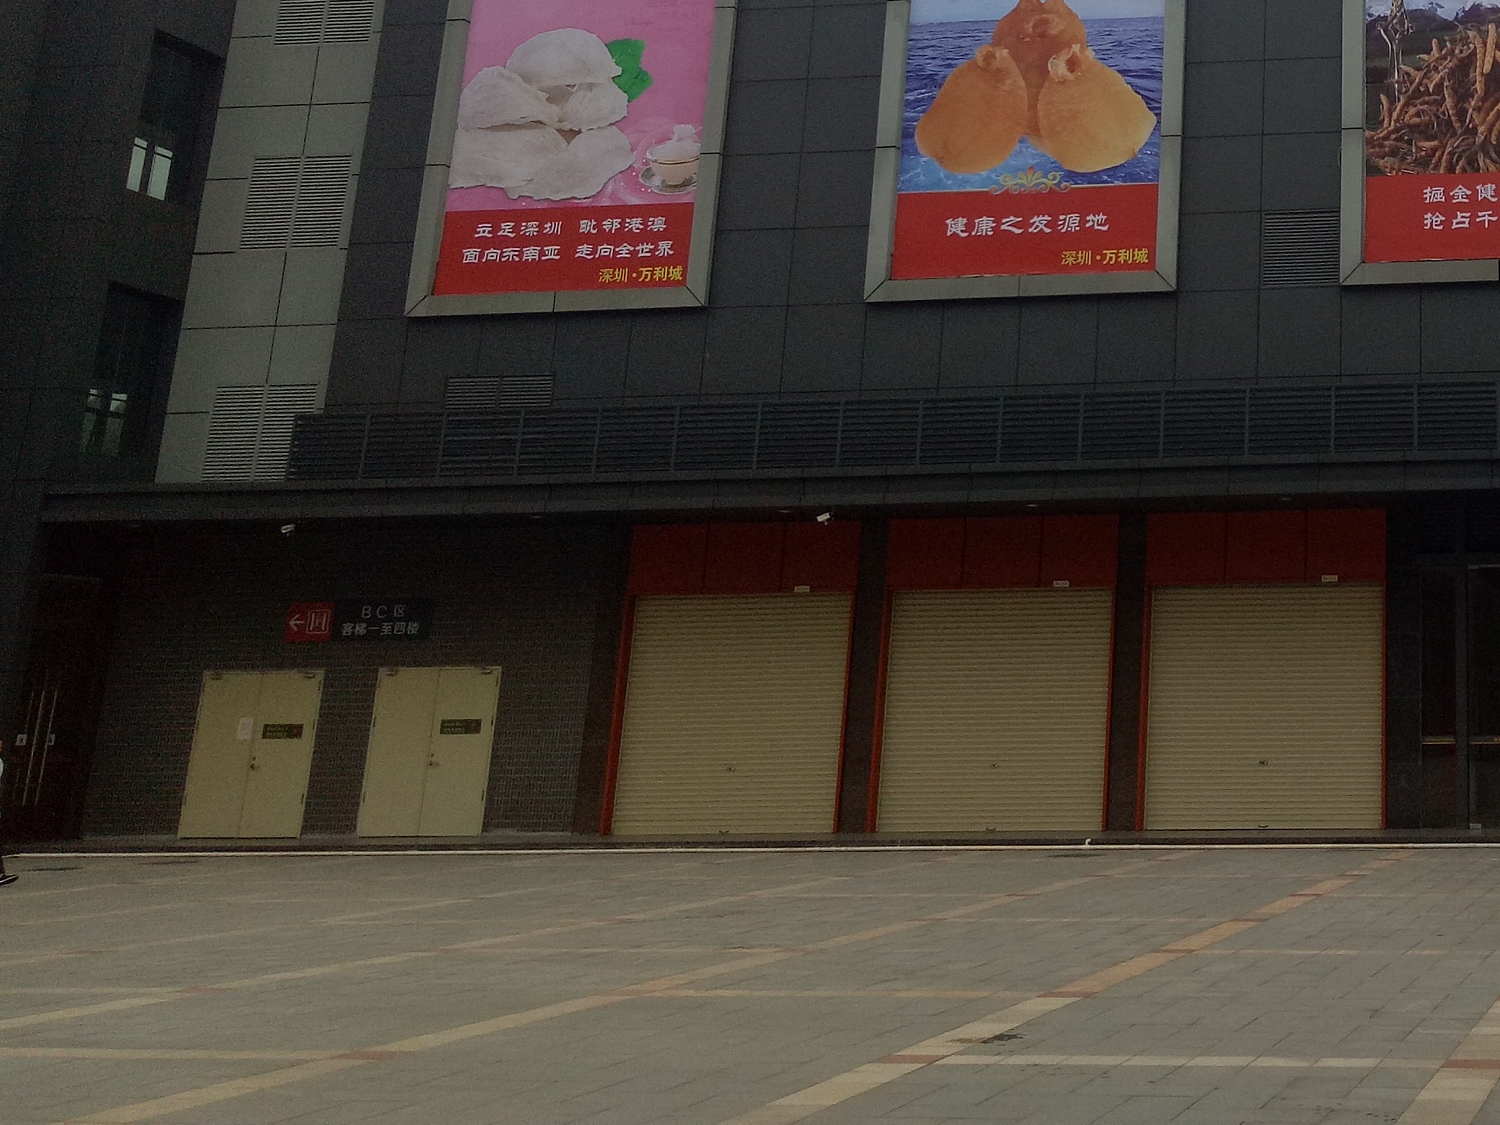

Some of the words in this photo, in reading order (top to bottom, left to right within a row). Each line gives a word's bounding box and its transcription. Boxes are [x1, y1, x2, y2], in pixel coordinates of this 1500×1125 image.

[474, 221, 562, 238] 立足深圳
[579, 217, 667, 234] 毗邻港澳
[945, 212, 1110, 238] 健康之发源地
[462, 245, 561, 264] 面向东南亚
[575, 241, 674, 259] 走向全世界
